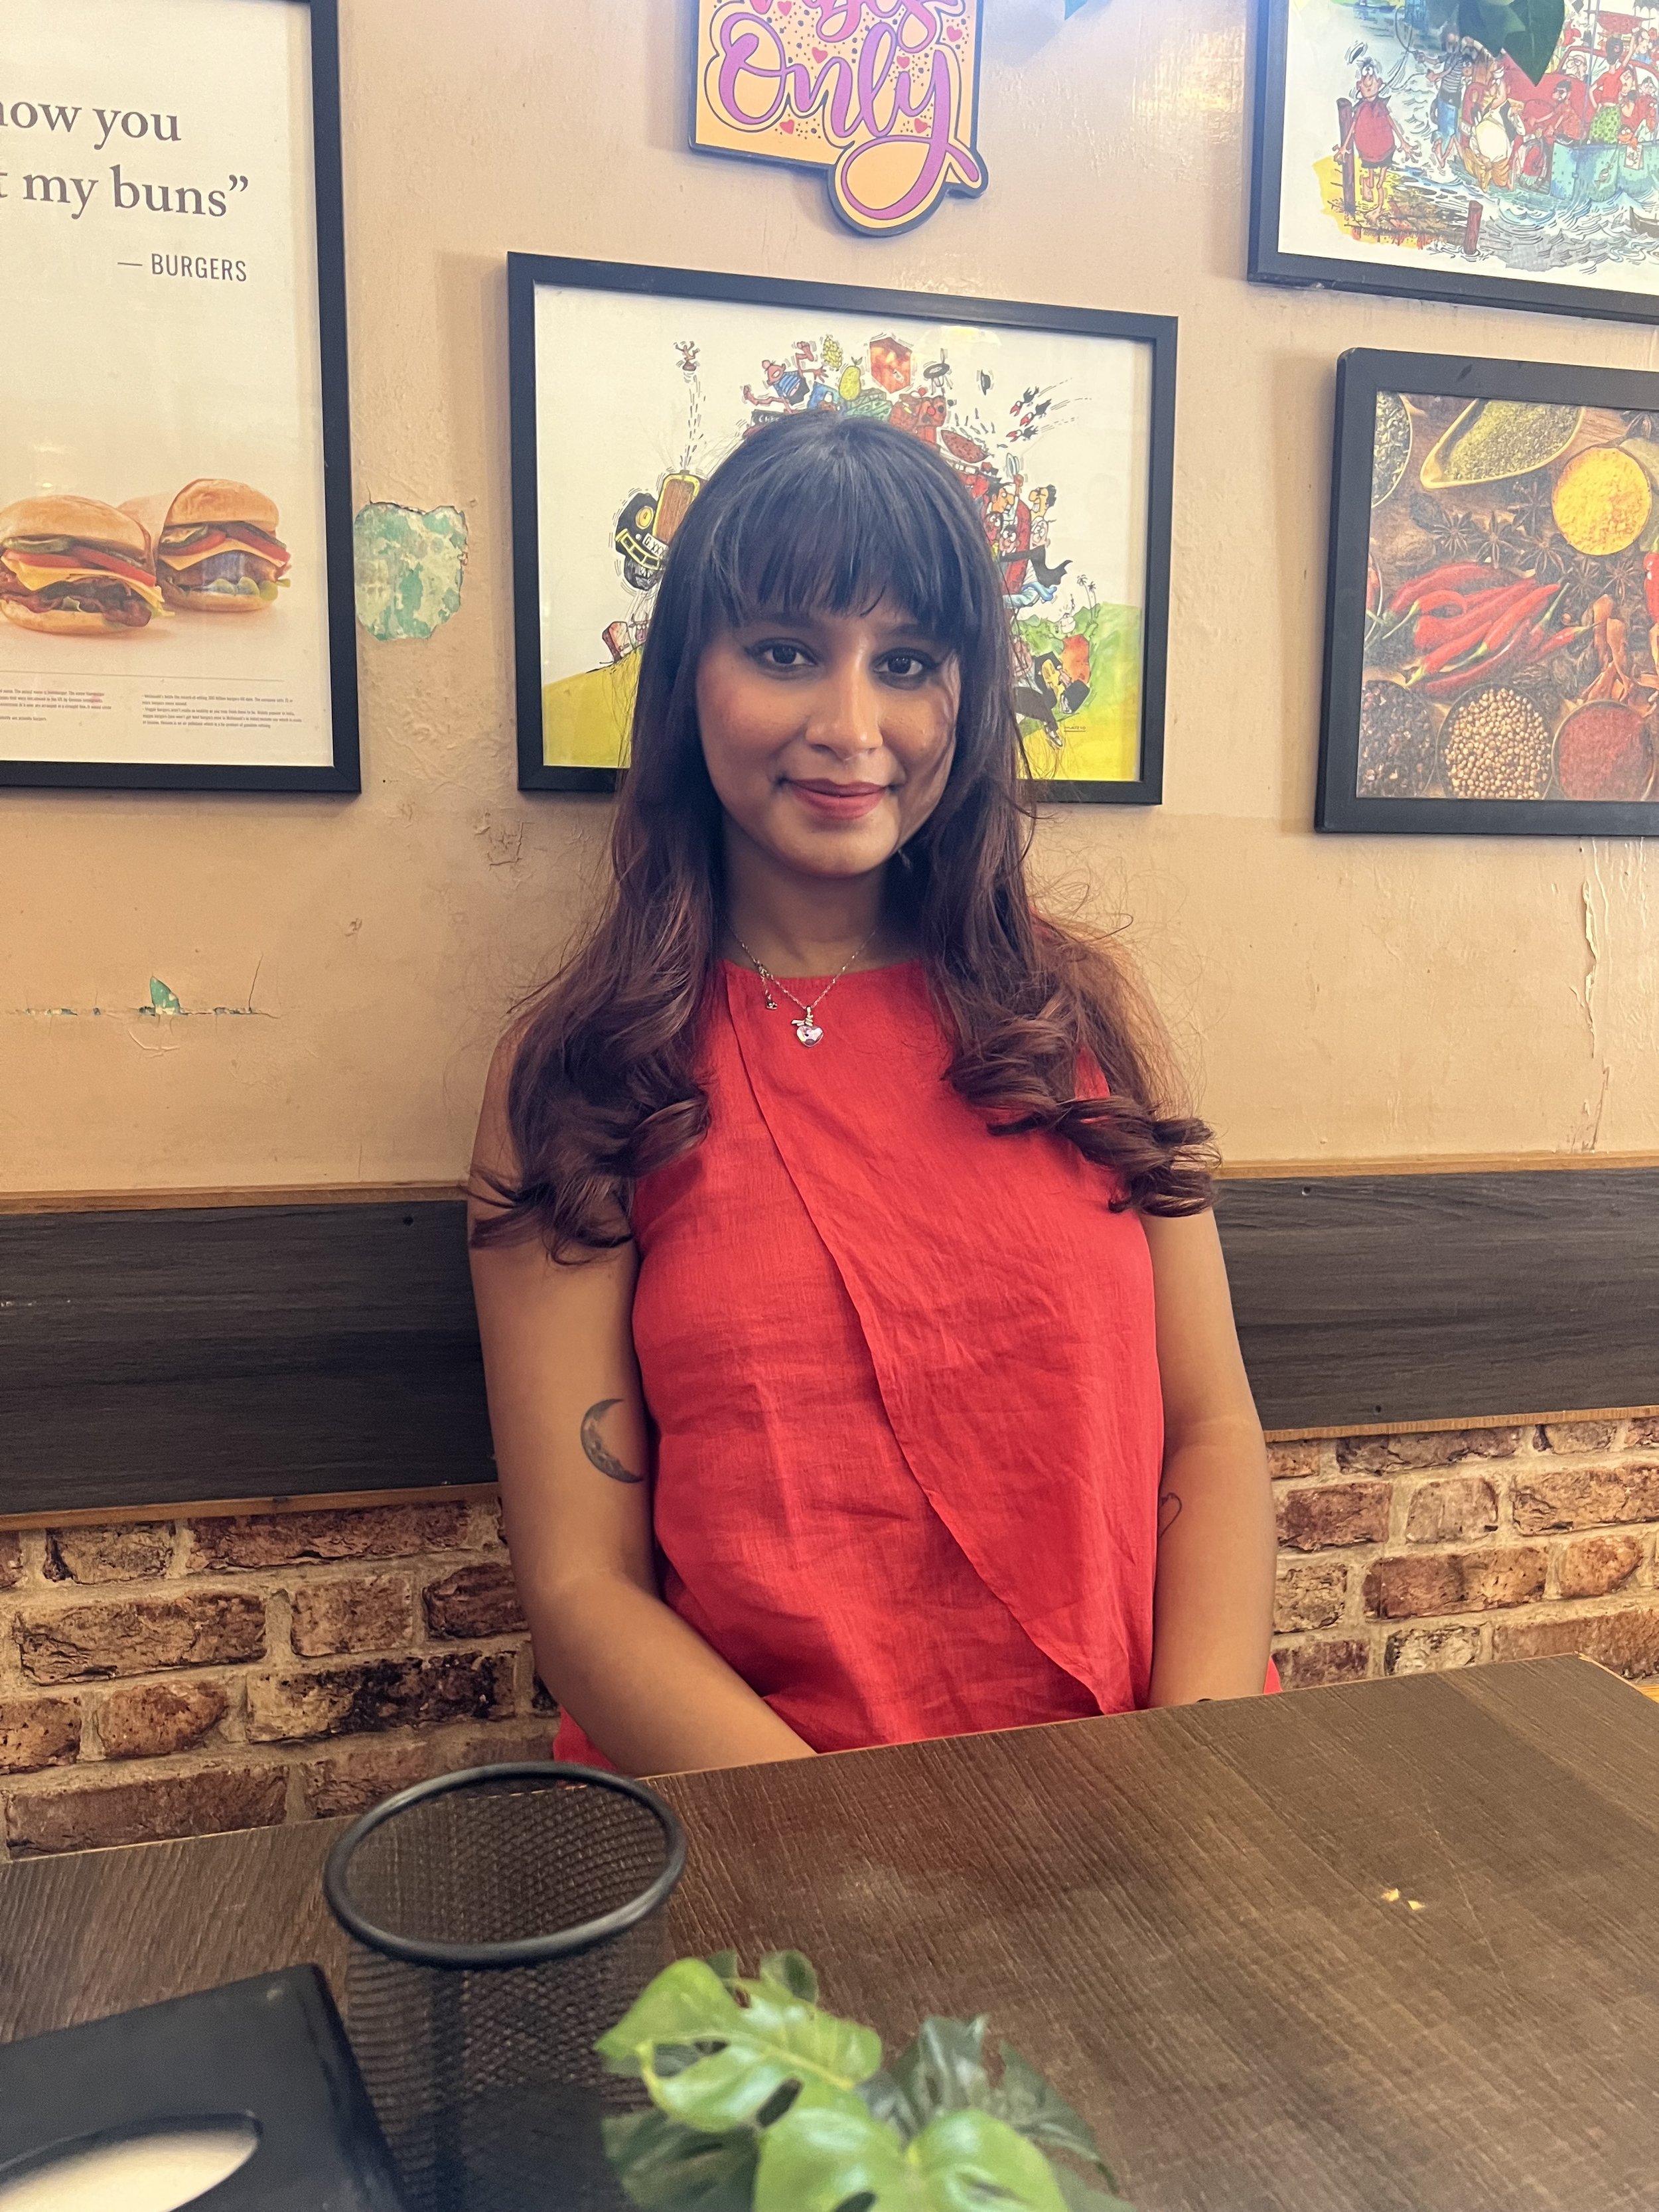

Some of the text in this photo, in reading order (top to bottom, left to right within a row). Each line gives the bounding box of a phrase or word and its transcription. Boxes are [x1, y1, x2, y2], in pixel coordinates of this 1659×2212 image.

[92, 108, 182, 151] you
[719, 12, 979, 220] Only
[23, 174, 99, 220] my
[151, 253, 247, 282] BURGERS
